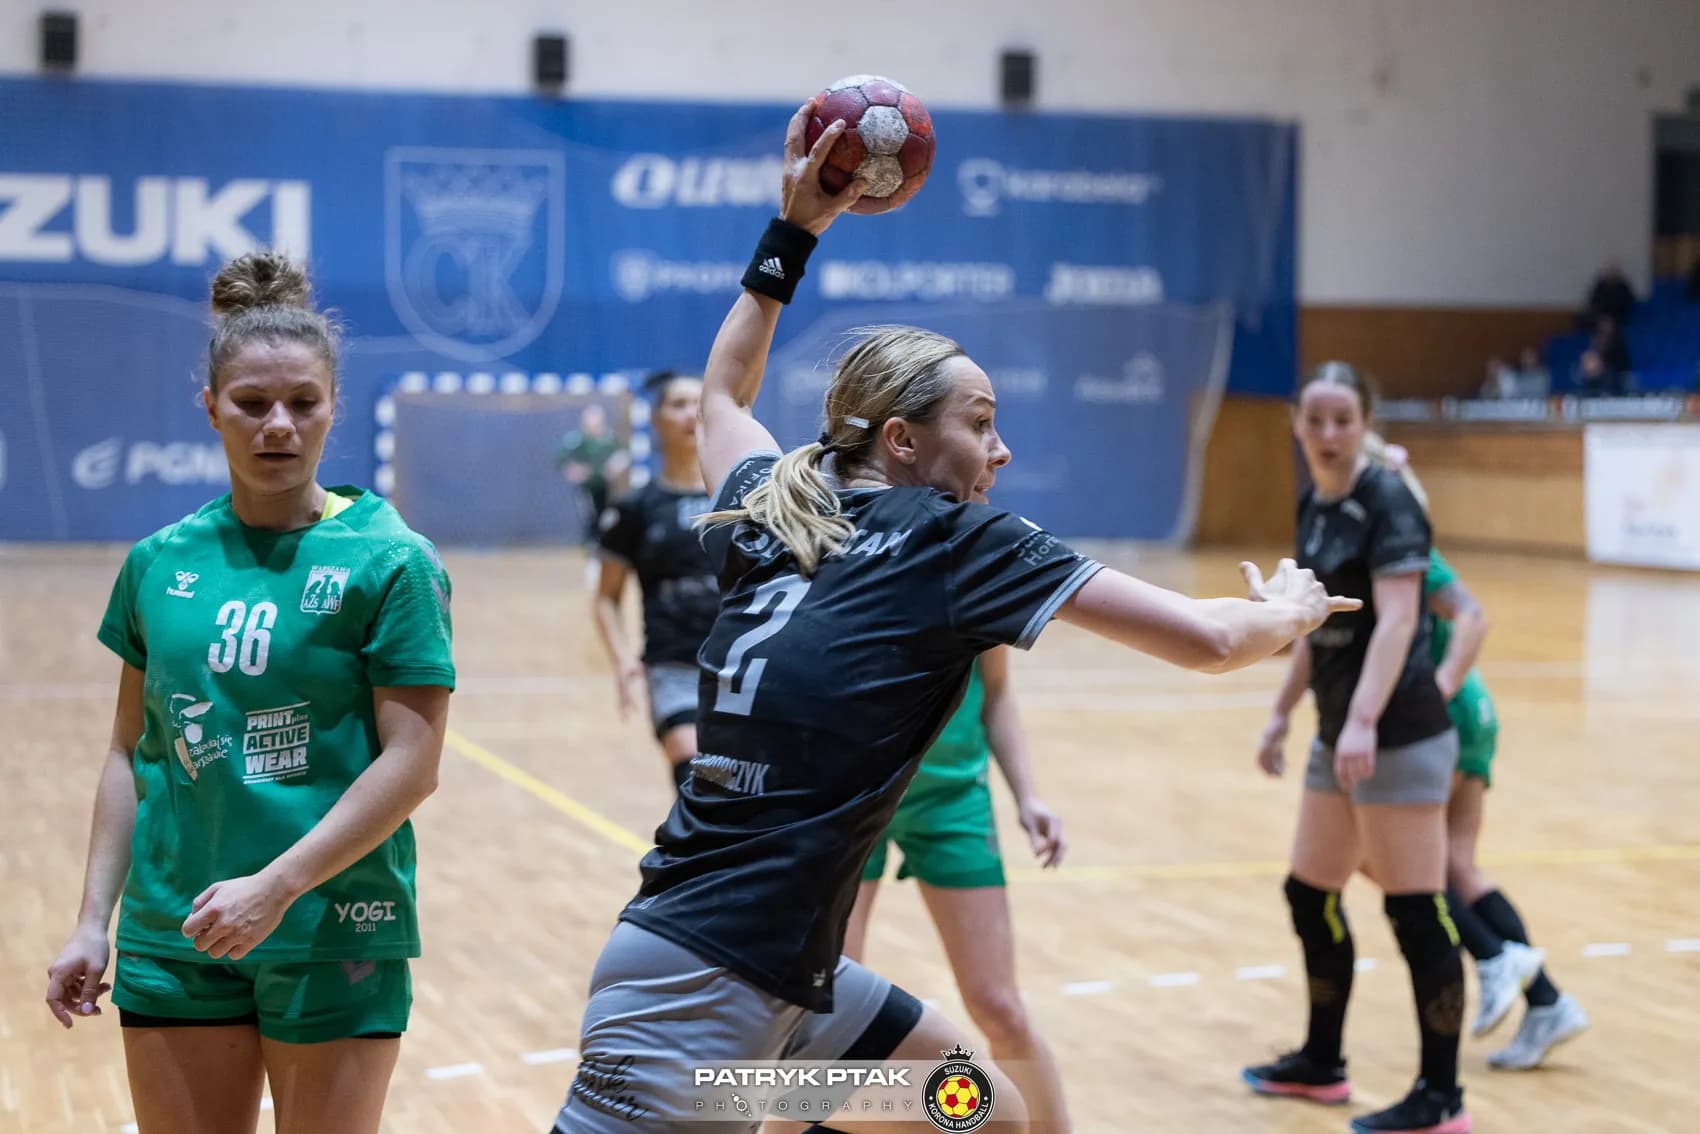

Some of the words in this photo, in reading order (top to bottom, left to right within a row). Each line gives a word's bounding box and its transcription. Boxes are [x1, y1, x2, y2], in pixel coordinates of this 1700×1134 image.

[0, 172, 310, 267] ZUKI
[759, 264, 785, 279] adidas
[208, 600, 277, 676] 36
[713, 574, 812, 715] 2
[247, 710, 294, 731] PRINT
[245, 726, 308, 753] ACTIVE
[245, 746, 307, 774] WEAR
[334, 901, 397, 923] YOGI
[355, 923, 377, 932] 2011
